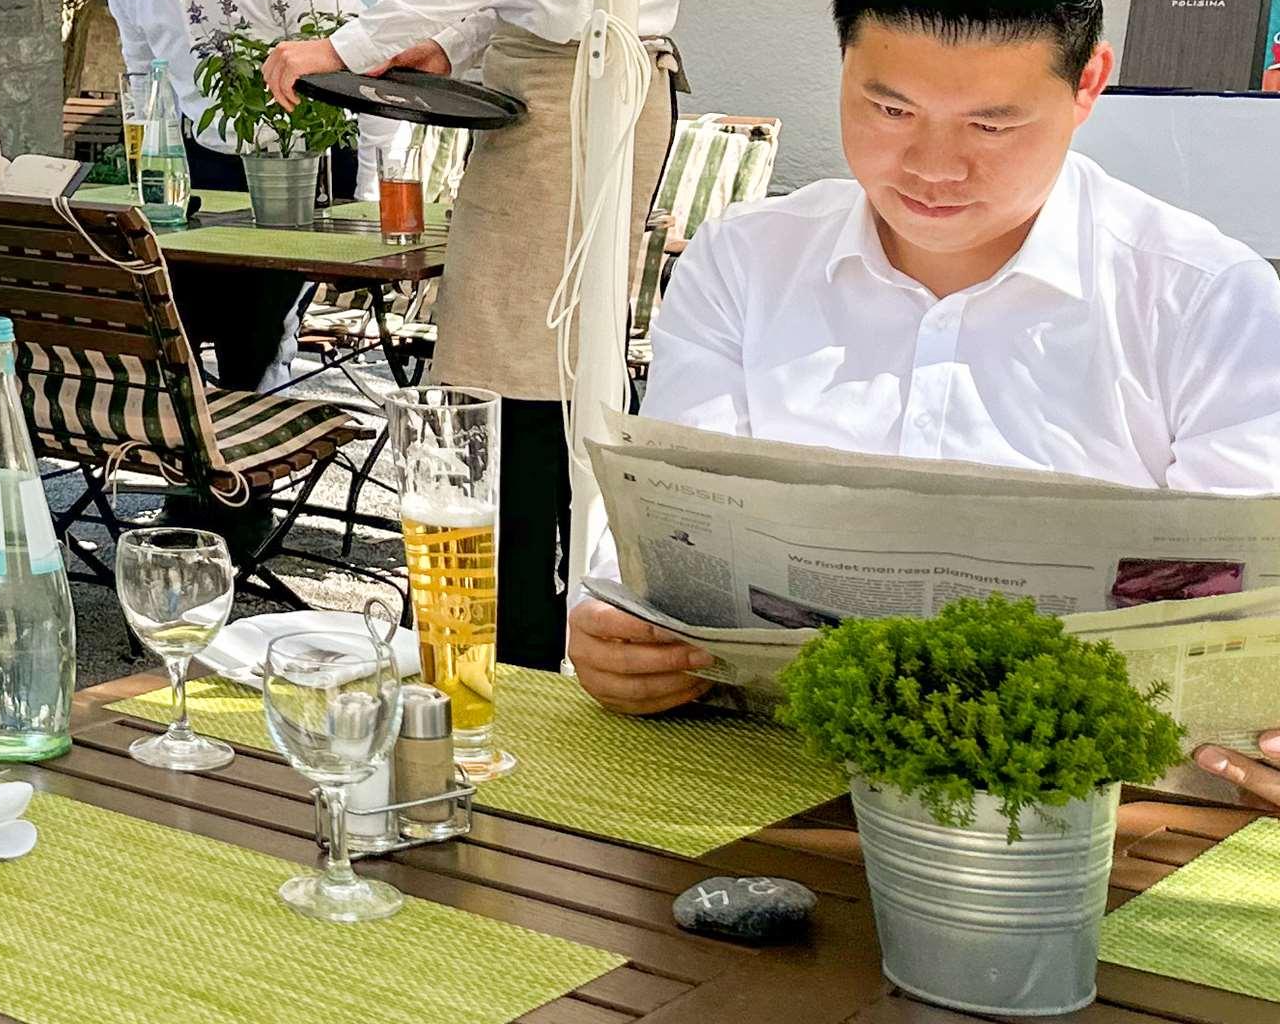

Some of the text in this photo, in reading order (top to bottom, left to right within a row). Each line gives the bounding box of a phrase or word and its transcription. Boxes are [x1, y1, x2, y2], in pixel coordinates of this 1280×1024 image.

[1171, 0, 1226, 7] POLISINA
[647, 478, 744, 509] WISSEN
[815, 560, 858, 572] findet
